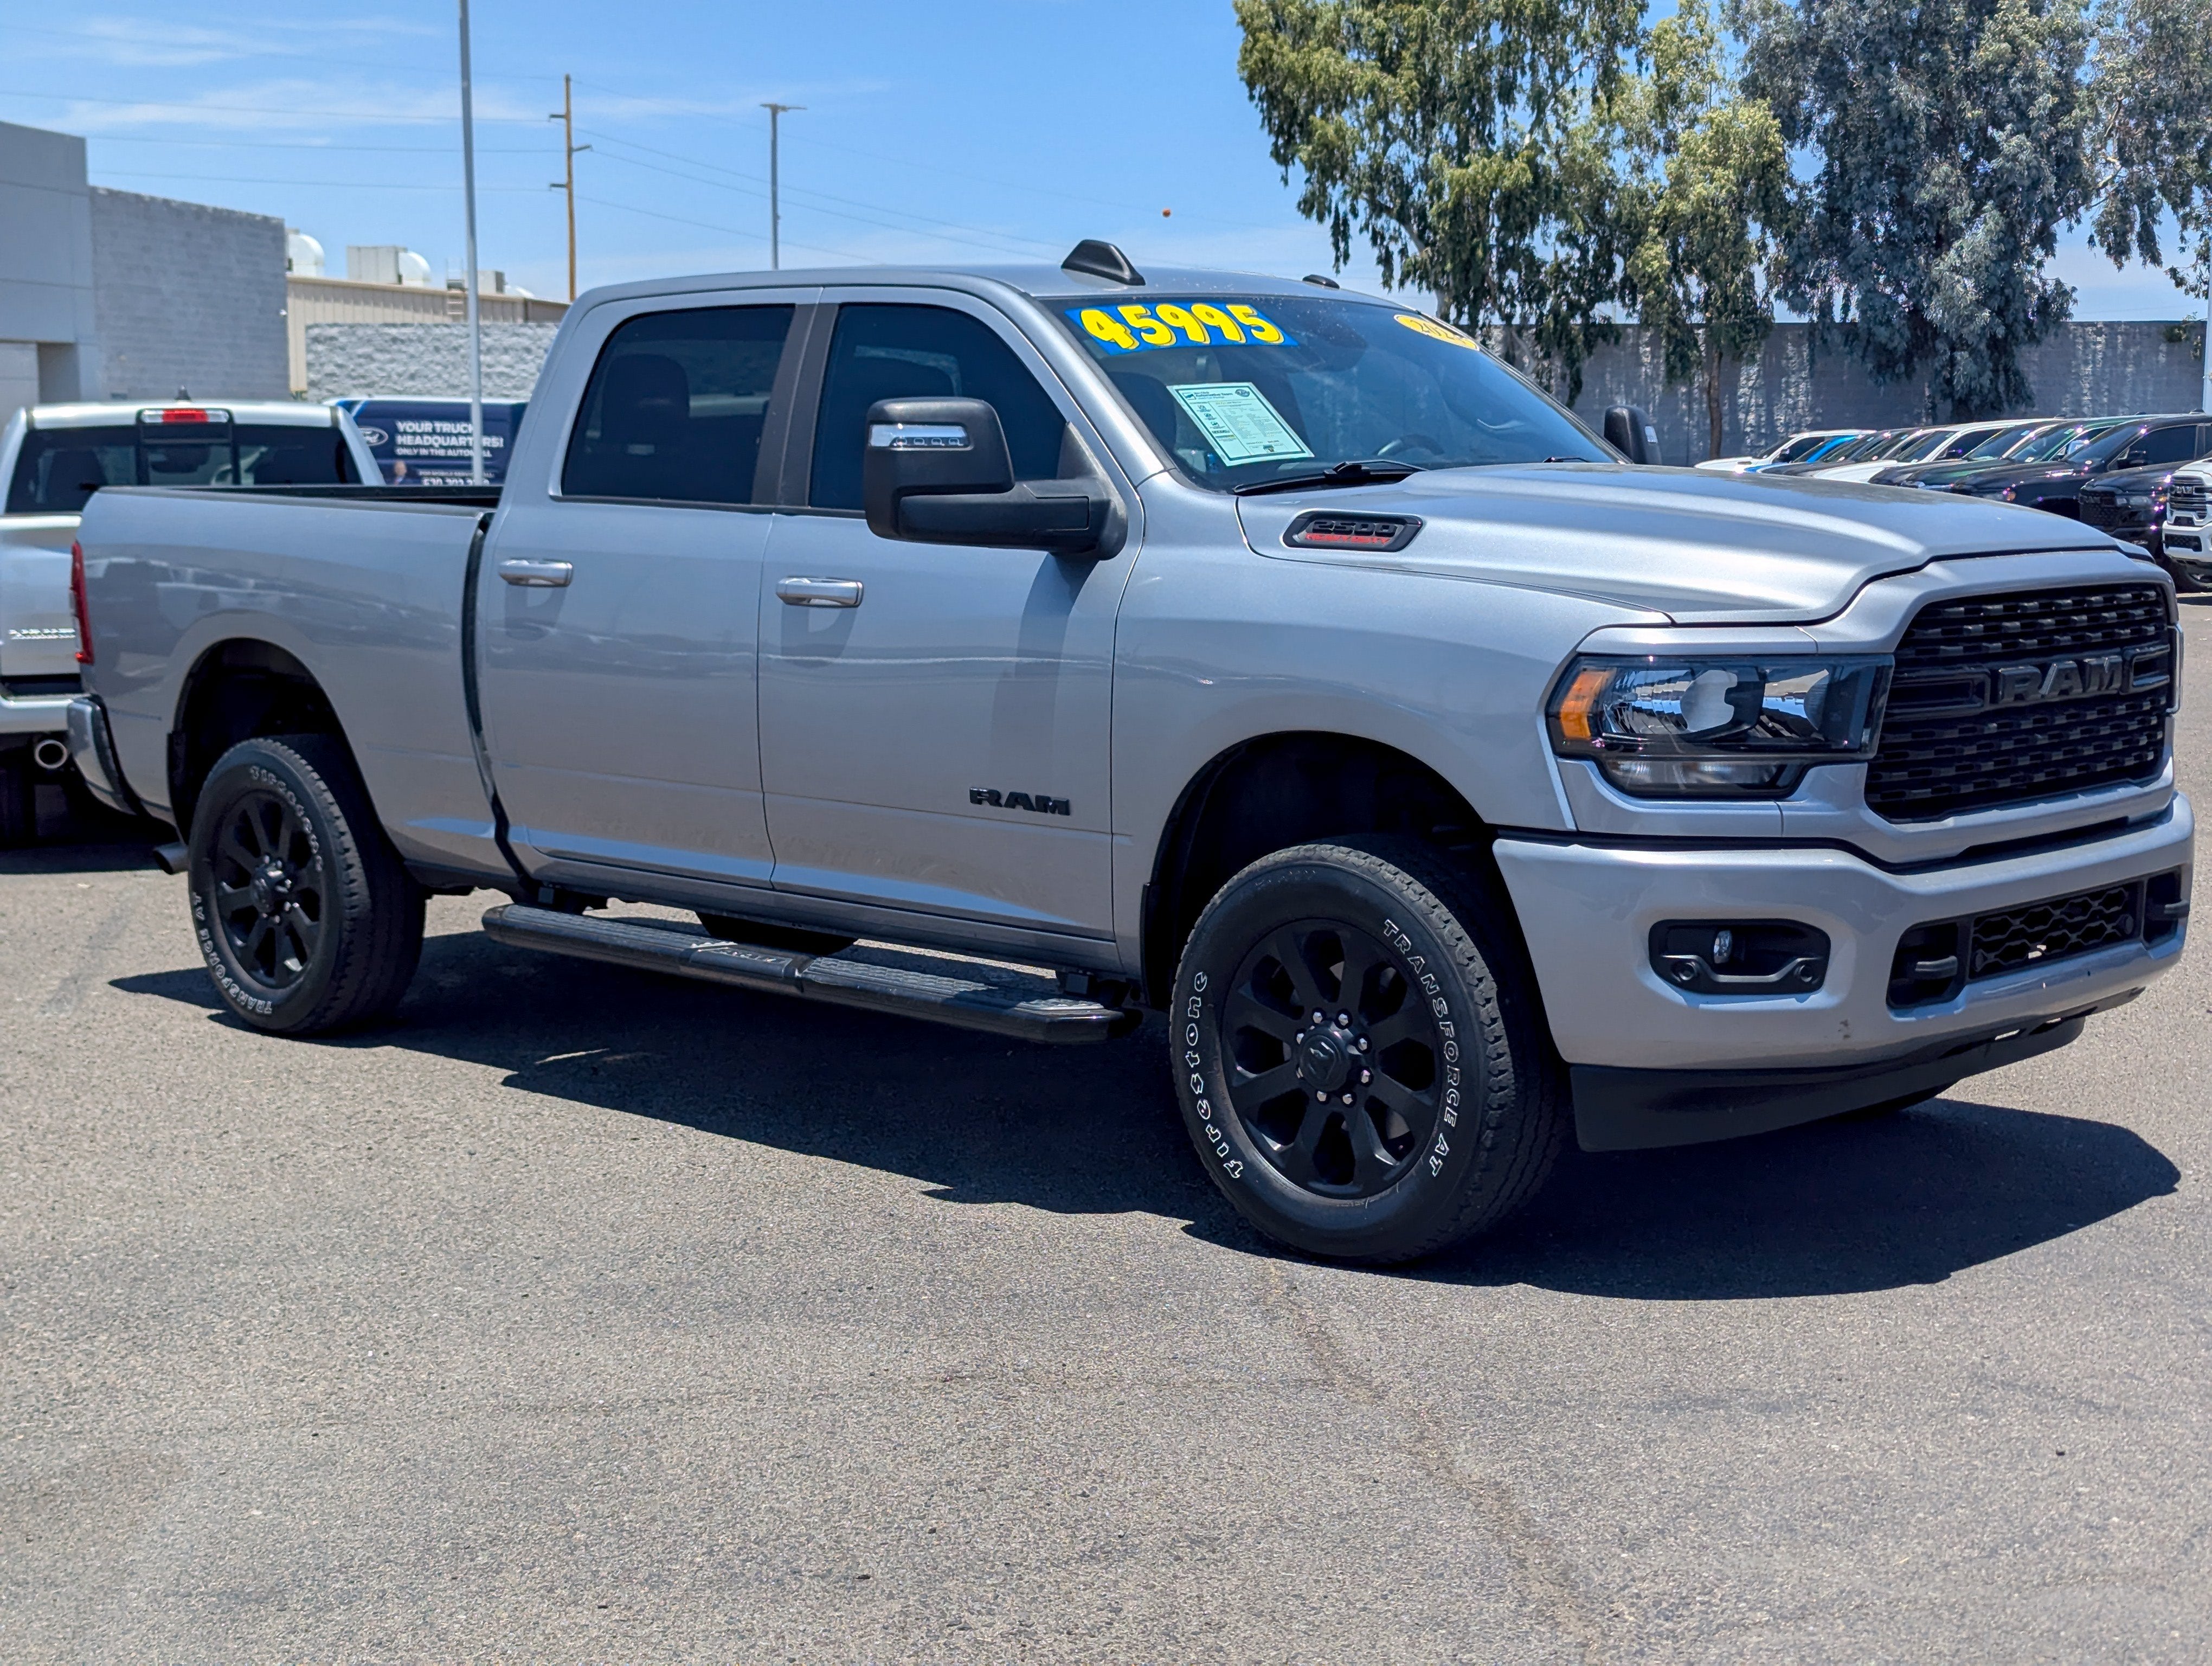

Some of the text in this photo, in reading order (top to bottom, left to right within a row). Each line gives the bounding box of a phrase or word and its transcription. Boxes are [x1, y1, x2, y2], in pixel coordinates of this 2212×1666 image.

[1081, 303, 1284, 349] 45995
[396, 421, 433, 433] YOUR
[396, 434, 504, 447] HEADQUARTRS!
[1312, 520, 1397, 537] 2500
[1998, 655, 2123, 704] RAM
[969, 787, 1070, 816] RAM
[1383, 919, 1461, 1177] TRANSFORCE AT
[1186, 971, 1244, 1178] Firestone
